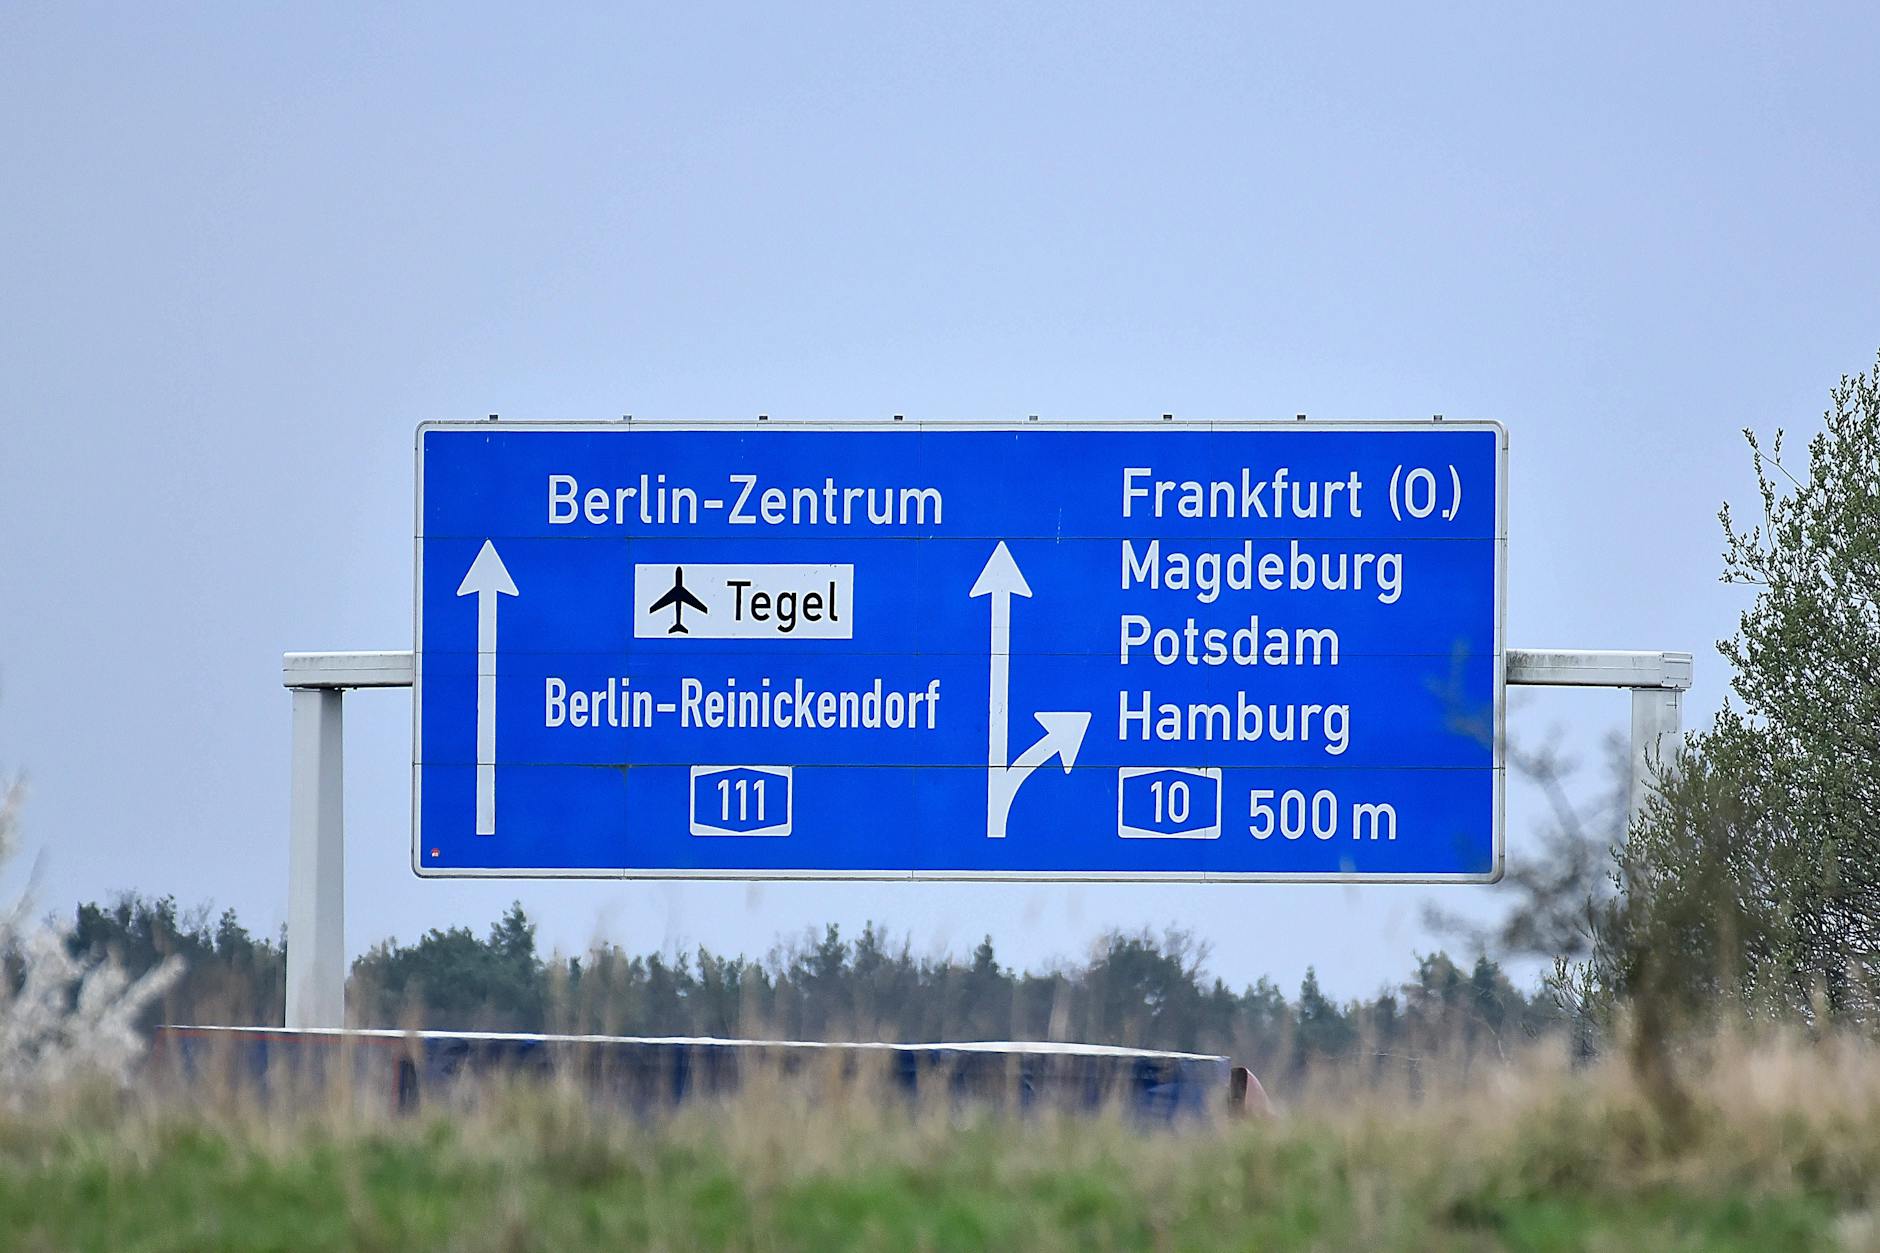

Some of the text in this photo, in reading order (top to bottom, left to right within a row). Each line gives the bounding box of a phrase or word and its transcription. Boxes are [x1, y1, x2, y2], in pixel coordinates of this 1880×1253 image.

[548, 474, 942, 525] Berlin-Zentrum
[1123, 464, 1462, 522] Frankfurt (O.)
[1121, 539, 1403, 604] Magdeburg
[726, 580, 839, 633] Tegel
[1120, 614, 1339, 666] Potsdam
[545, 677, 940, 729] Berlin-Reinickendorf
[1119, 690, 1350, 755] Hamburg
[717, 779, 766, 821] 111
[1150, 780, 1190, 824] 10
[1249, 789, 1397, 840] 500 m
